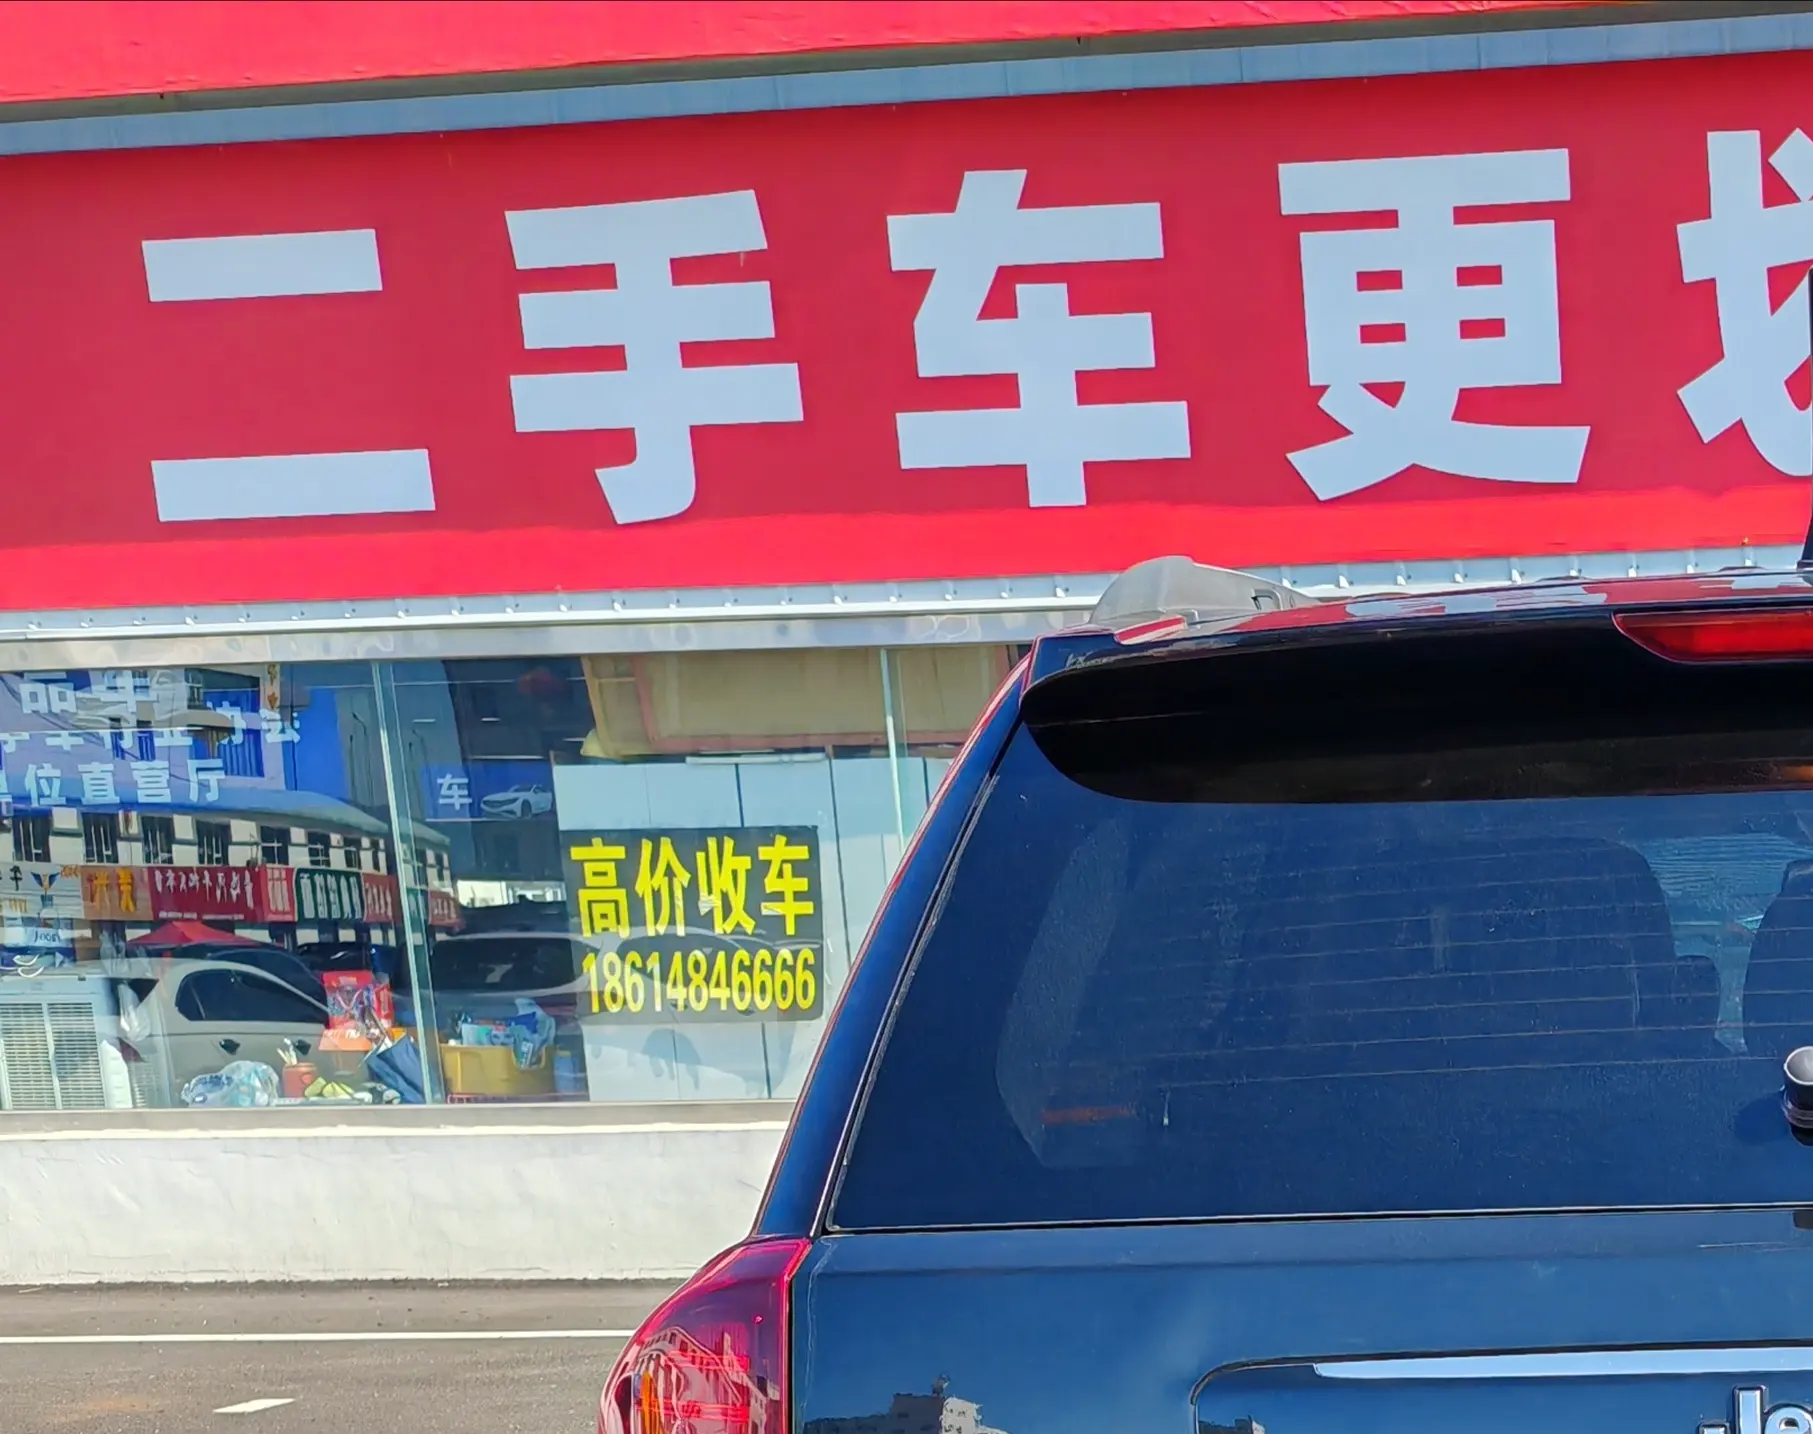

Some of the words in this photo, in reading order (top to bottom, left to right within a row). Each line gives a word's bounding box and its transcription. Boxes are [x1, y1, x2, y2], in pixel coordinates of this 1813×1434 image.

[0, 758, 225, 808] 位直营厅
[436, 773, 473, 811] 车
[570, 835, 815, 938] 高价收车
[581, 948, 816, 1014] 18614846666
